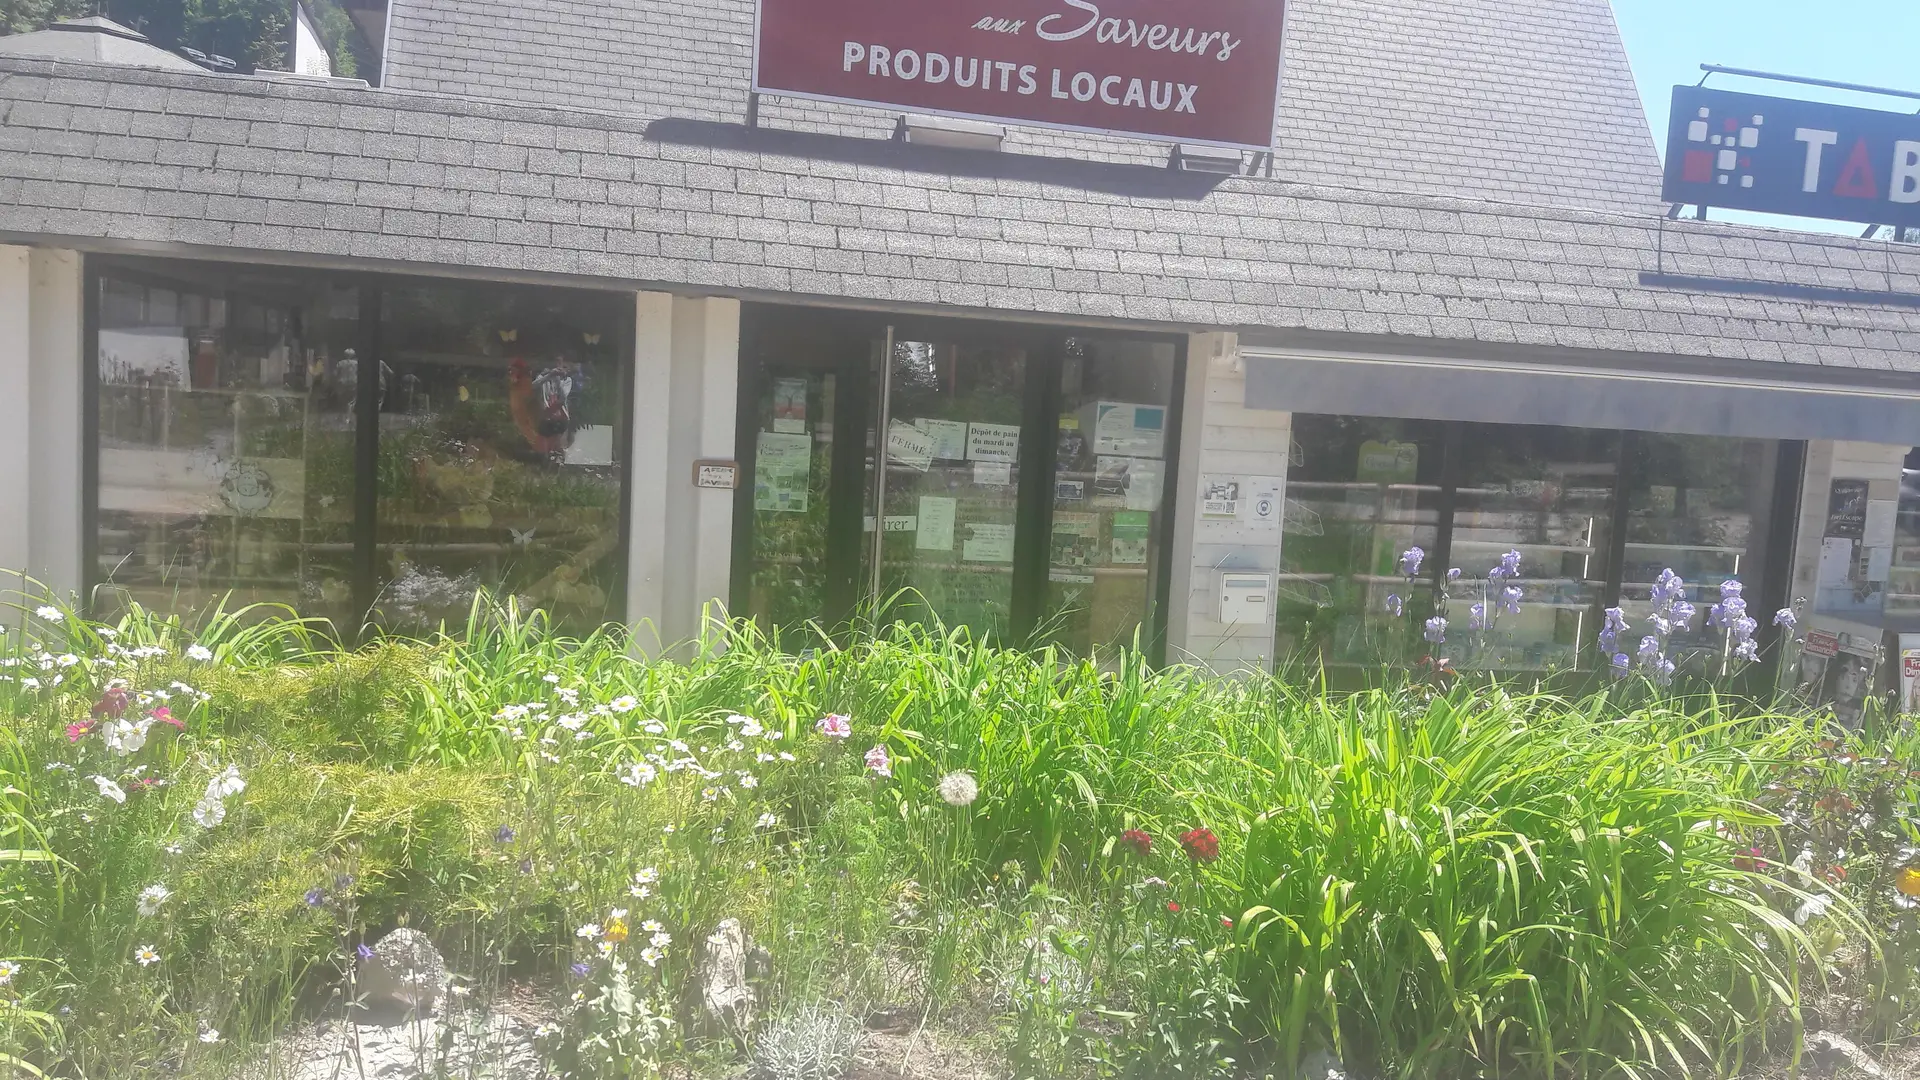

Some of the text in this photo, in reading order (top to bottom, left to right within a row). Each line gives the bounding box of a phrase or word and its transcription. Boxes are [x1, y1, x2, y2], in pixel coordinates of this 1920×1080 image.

[971, 0, 1242, 62] aux Saveurs
[843, 41, 1199, 114] PRODUITS LOCAUX
[1002, 431, 1018, 439] pain
